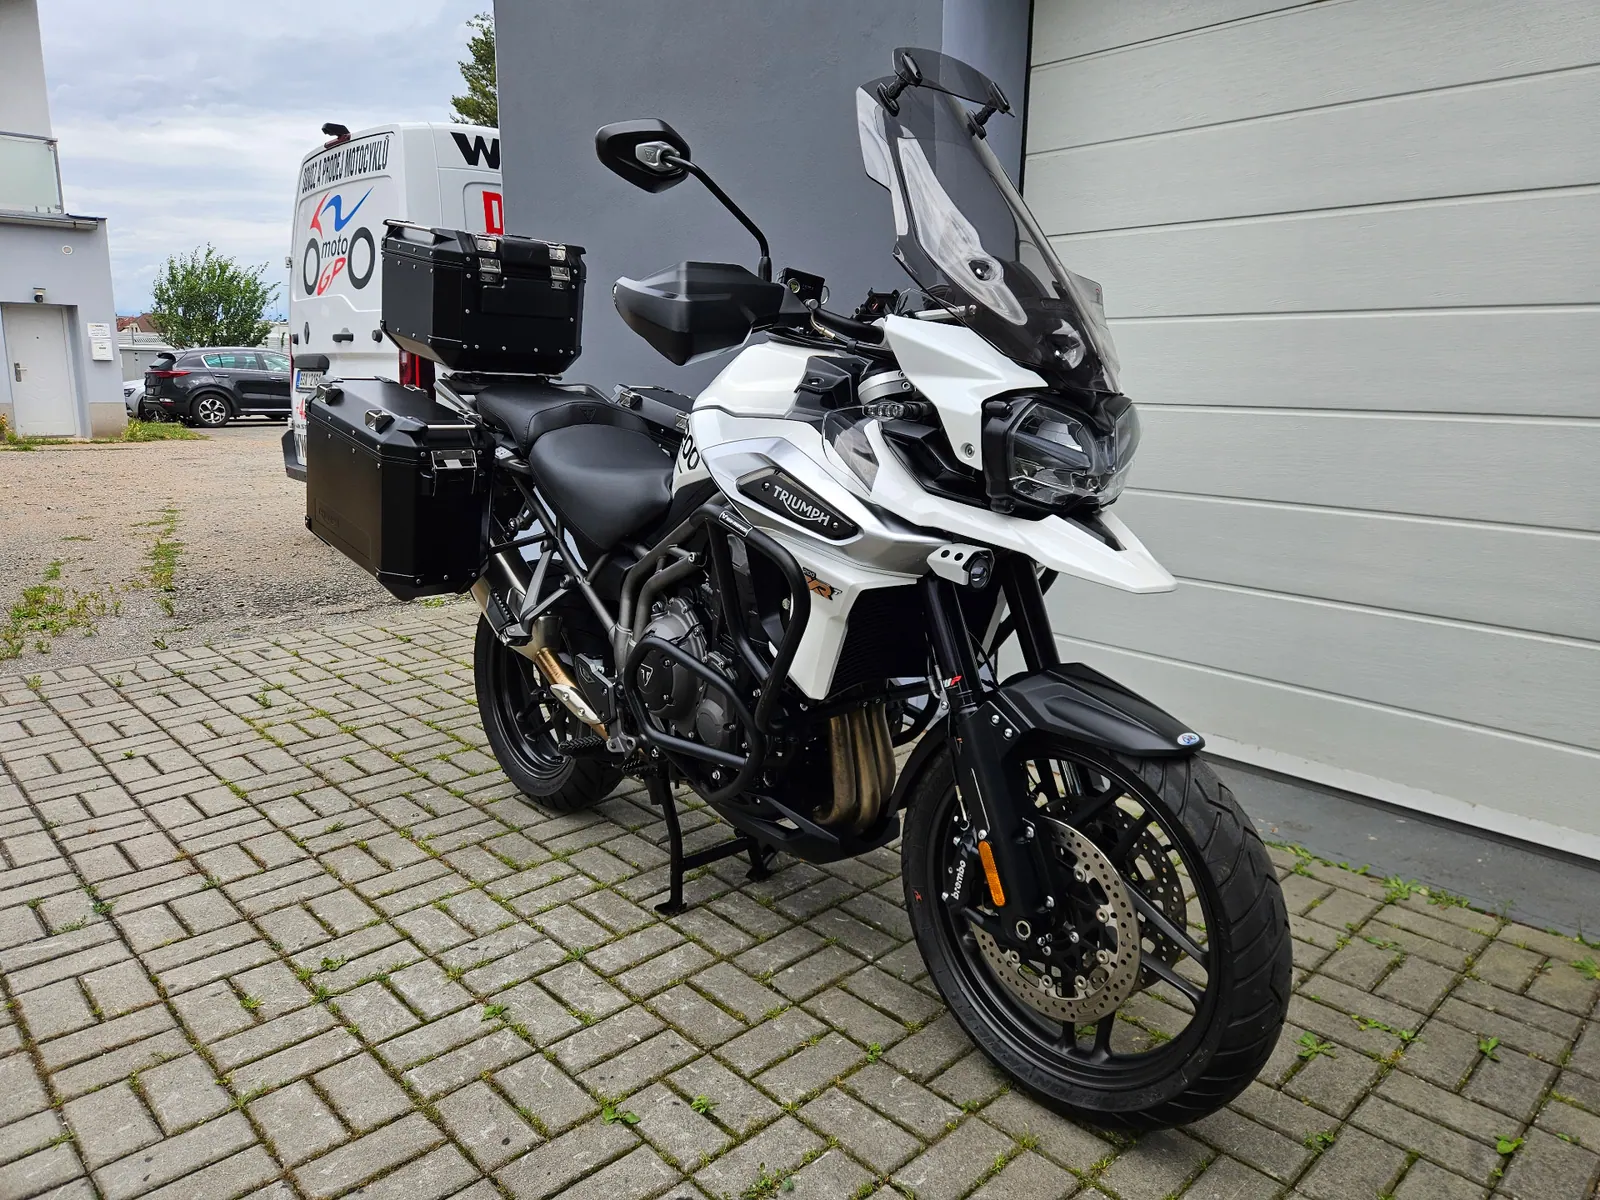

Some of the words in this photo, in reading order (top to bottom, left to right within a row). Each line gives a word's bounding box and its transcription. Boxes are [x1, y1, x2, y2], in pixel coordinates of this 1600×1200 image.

[321, 151, 345, 186] PRODEJ
[344, 135, 390, 179] MOTOCYKLŮ
[321, 234, 349, 259] moto
[317, 257, 346, 296] GP
[773, 485, 830, 526] TRIUMPH
[951, 859, 967, 901] brembo
